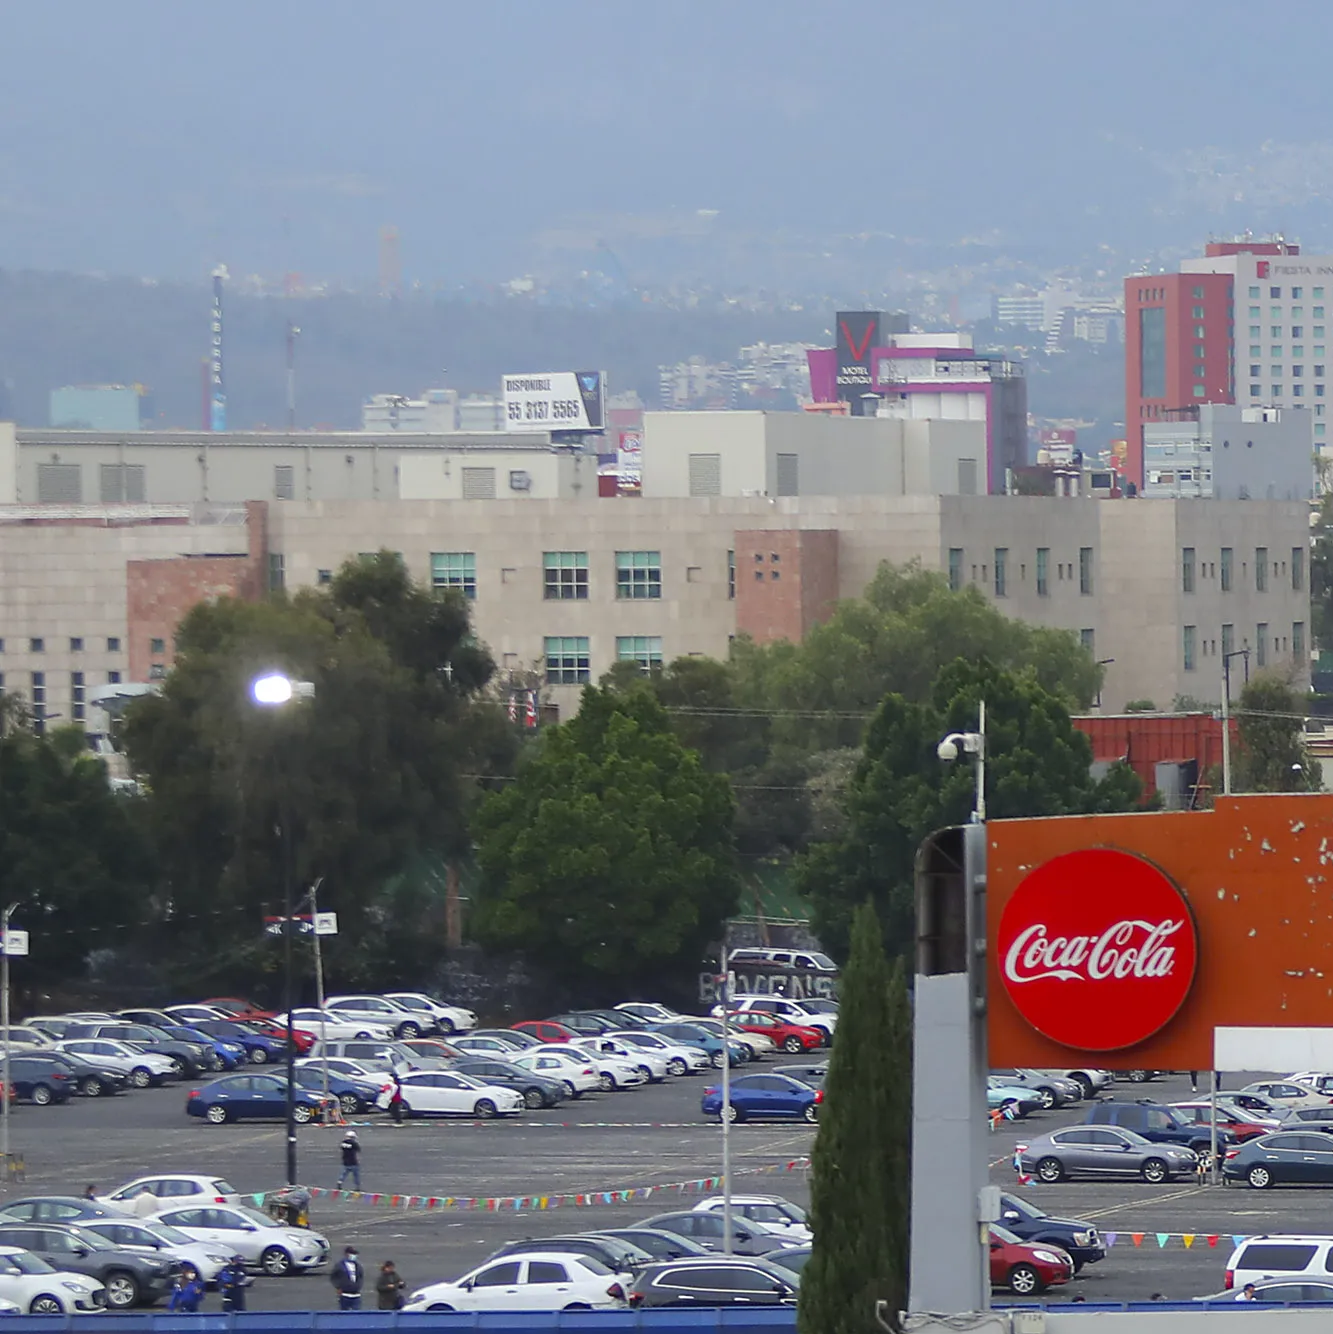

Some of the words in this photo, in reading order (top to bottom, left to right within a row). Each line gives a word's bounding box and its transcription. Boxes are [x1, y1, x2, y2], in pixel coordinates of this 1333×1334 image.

[1274, 265, 1312, 275] FIESTA
[210, 296, 222, 385] INBURSA
[840, 320, 876, 361] V
[841, 366, 869, 375] MOTEL
[506, 379, 552, 392] DISPONIBLE
[508, 401, 521, 420] 55
[526, 400, 549, 420] 3137
[553, 400, 580, 419] 5565
[1005, 918, 1185, 983] Coca-Cola
